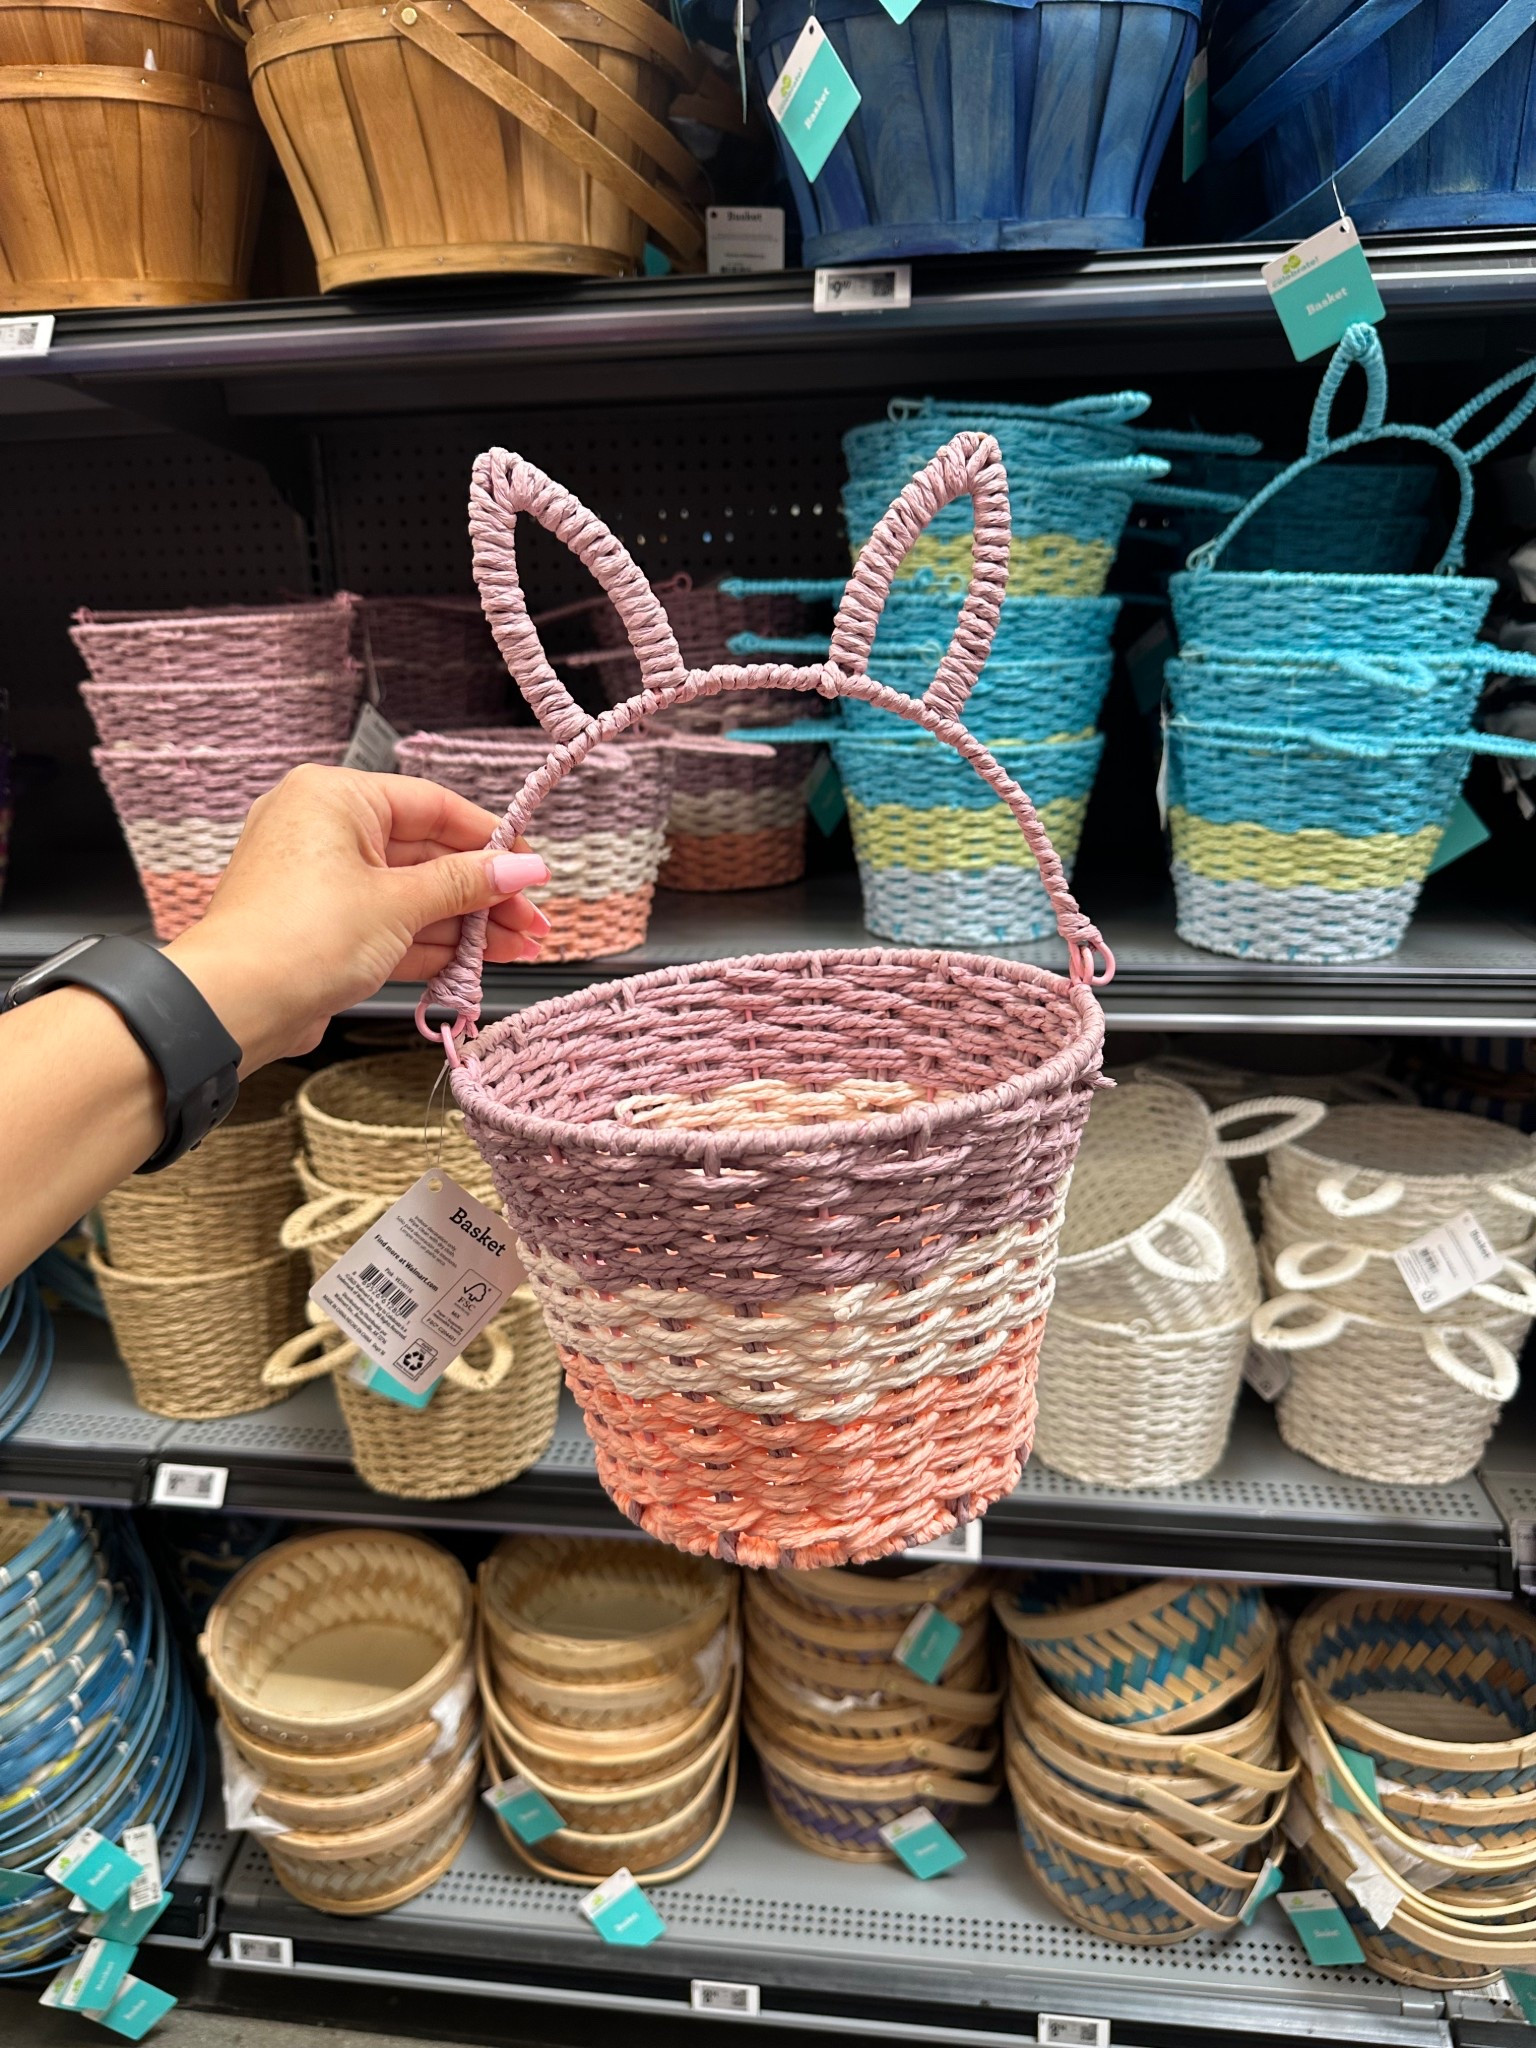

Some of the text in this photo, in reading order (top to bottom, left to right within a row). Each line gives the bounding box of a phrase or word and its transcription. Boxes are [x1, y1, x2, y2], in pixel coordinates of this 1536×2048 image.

[804, 86, 830, 131] Basket
[1306, 287, 1348, 316] Basket
[403, 1223, 414, 1233] para
[433, 1246, 441, 1254] de
[407, 1217, 420, 1228] Wipe
[417, 1225, 430, 1237] clean
[428, 1234, 439, 1244] with
[436, 1241, 445, 1250] dry
[412, 1237, 421, 1246] con
[414, 1215, 428, 1227] Indoor
[426, 1225, 448, 1244] decoration
[448, 1204, 510, 1258] Basket
[373, 1233, 439, 1292] Find more at Walmart.com
[384, 1267, 394, 1277] Pink
[333, 1292, 349, 1308] Walmart
[335, 1273, 354, 1291] trademark
[355, 1292, 371, 1308] Walmart
[379, 1314, 392, 1327] Rights
[354, 1282, 371, 1299] Walmart
[368, 1296, 376, 1304] Inc.
[373, 1301, 383, 1311] Way
[385, 1311, 402, 1327] Celebrate
[361, 1278, 381, 1298] 89526
[381, 1296, 401, 1317] 61280
[456, 1295, 475, 1312] FSC
[321, 1293, 333, 1305] MADE
[355, 1326, 363, 1334] EN
[360, 1331, 372, 1343] CHINA
